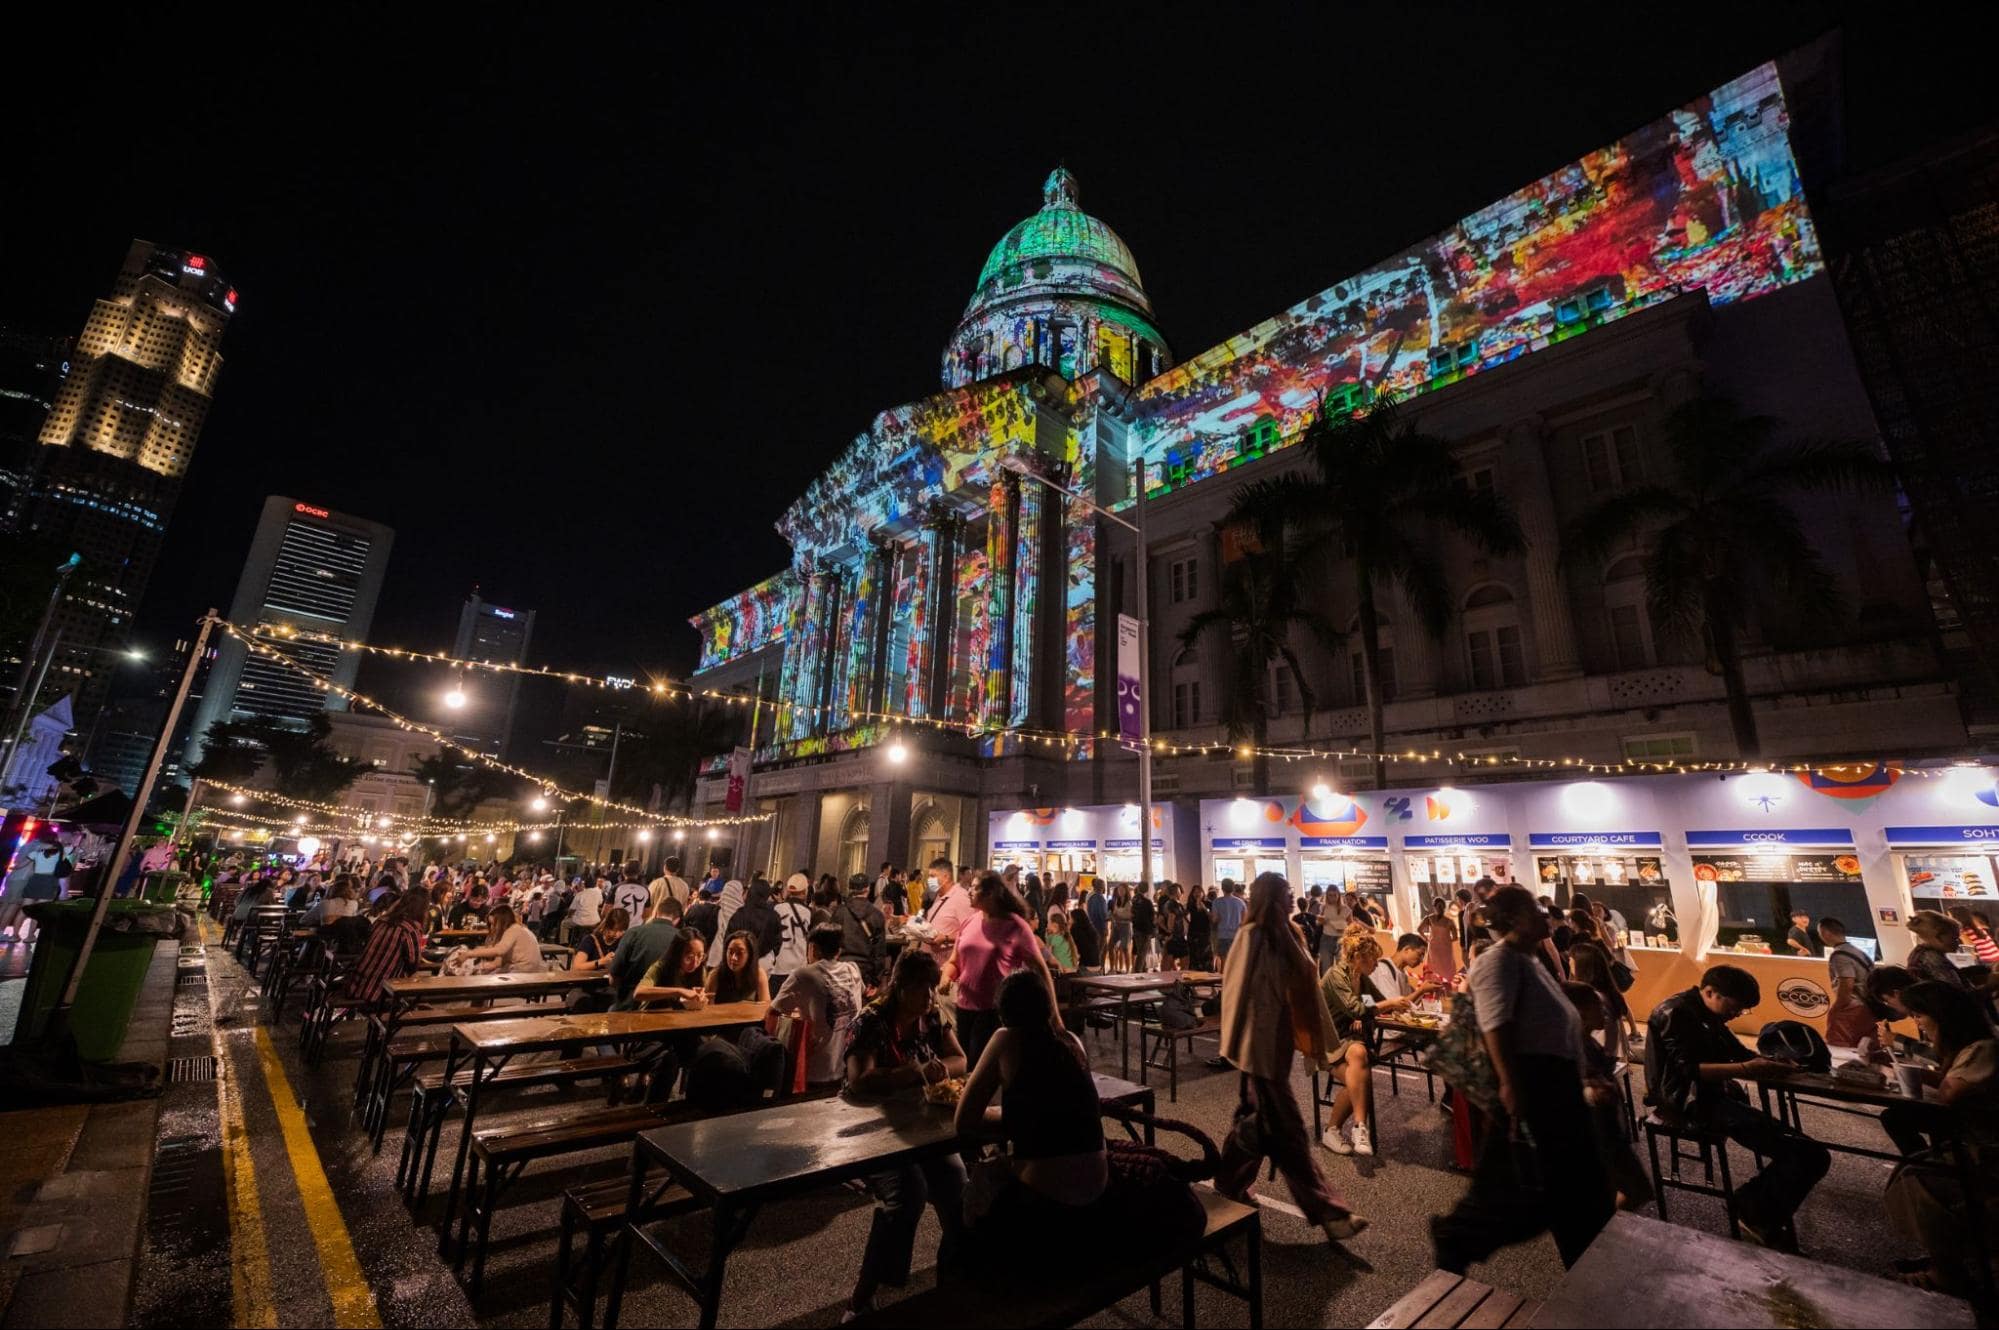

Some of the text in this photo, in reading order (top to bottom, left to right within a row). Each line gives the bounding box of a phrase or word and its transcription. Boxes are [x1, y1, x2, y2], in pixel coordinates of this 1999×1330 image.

[183, 265, 205, 276] UOB
[305, 506, 329, 518] OCBC
[1551, 835, 1636, 844] COURTYARD CAFE
[1742, 833, 1786, 842] CCOOK
